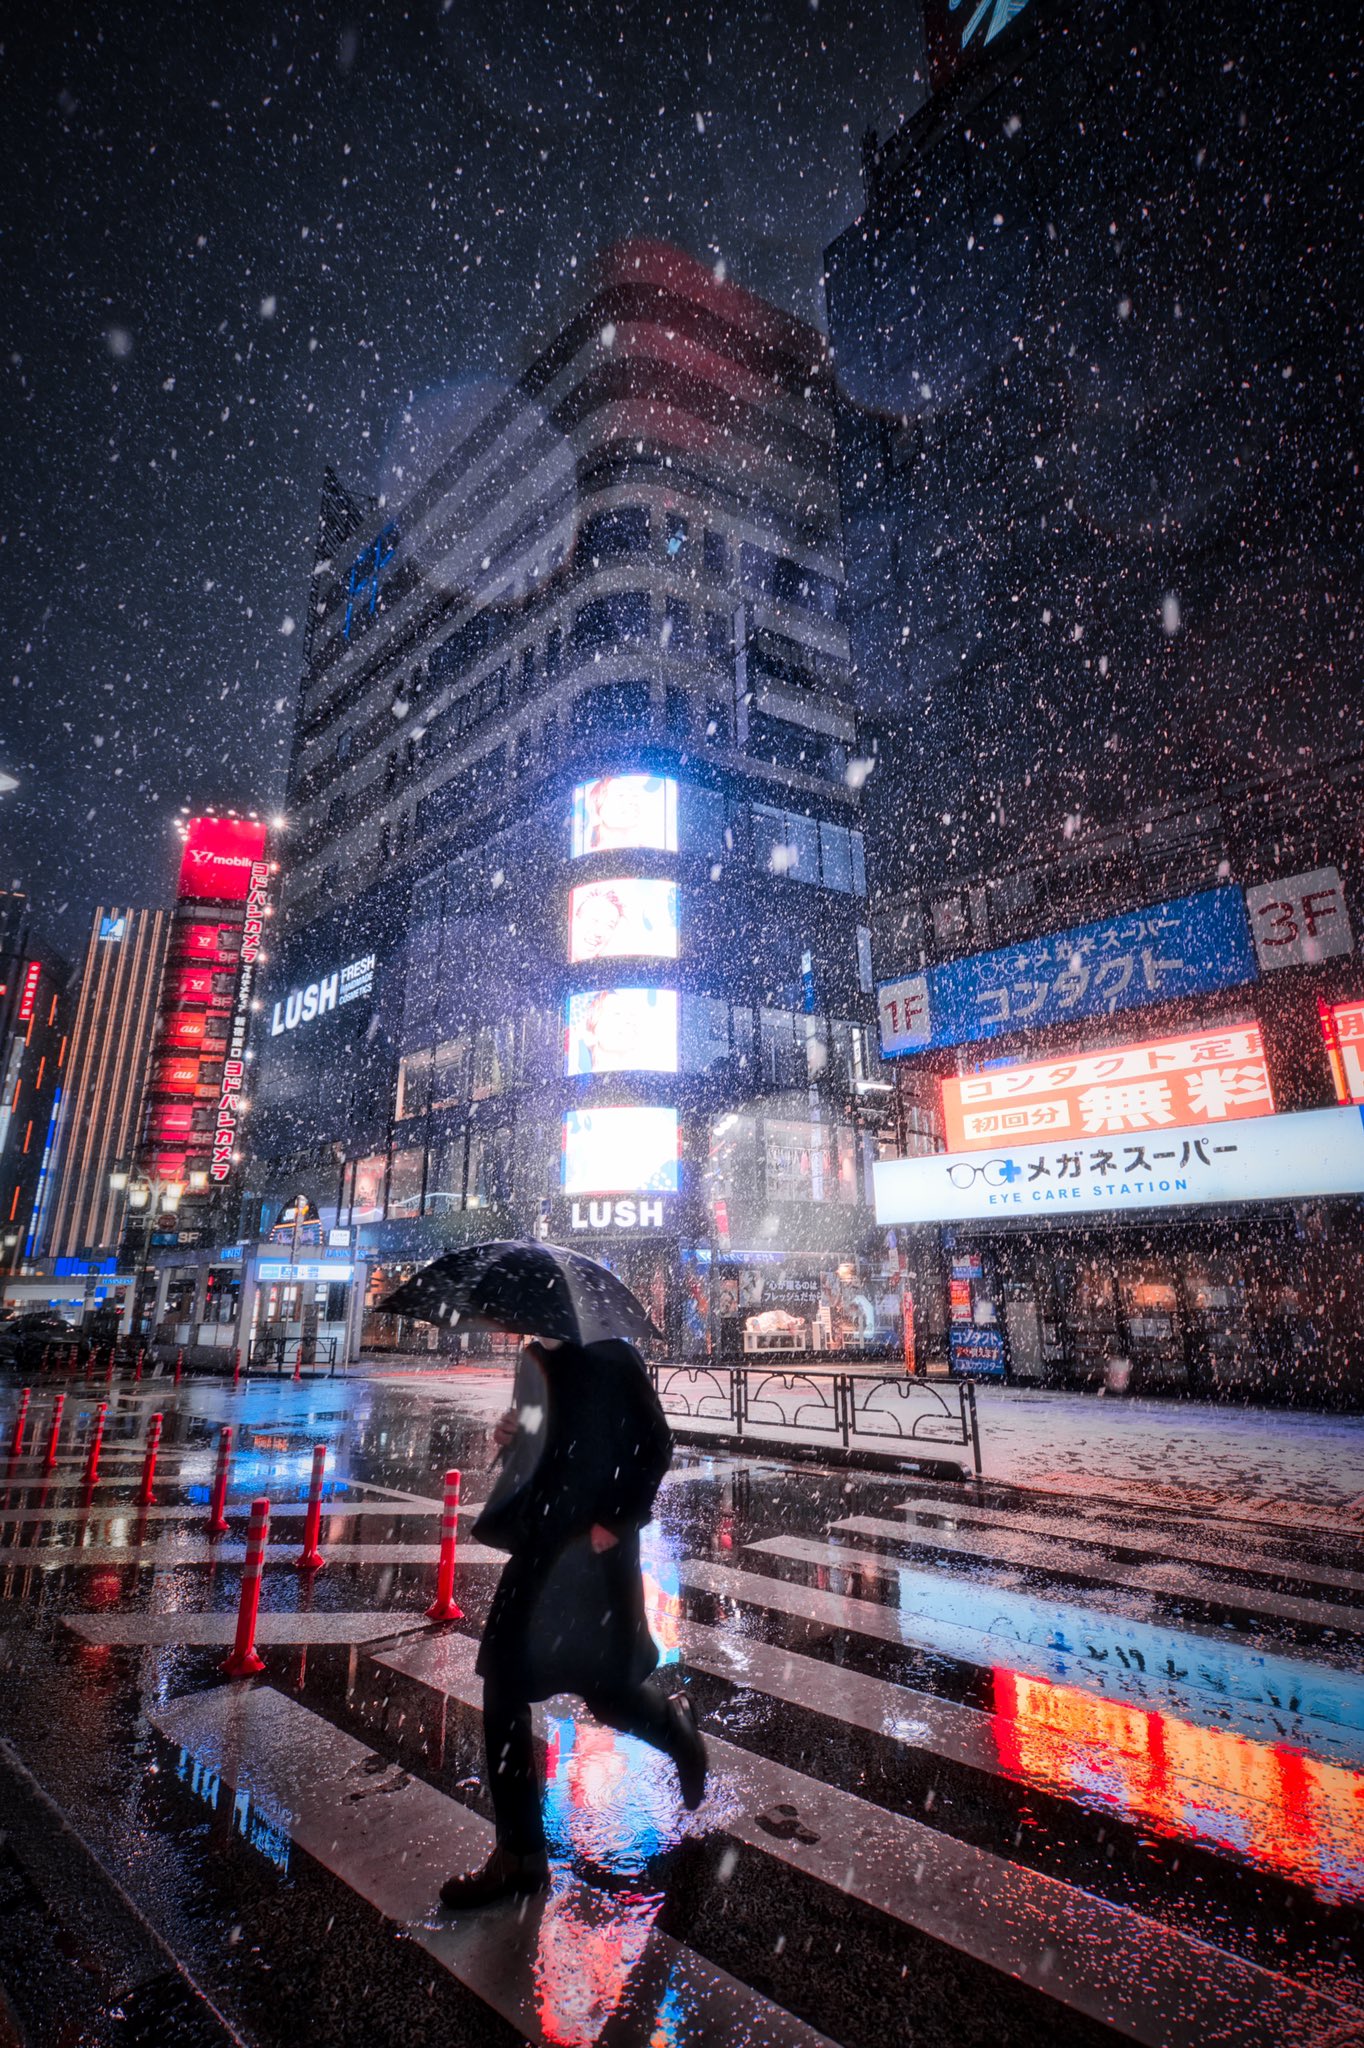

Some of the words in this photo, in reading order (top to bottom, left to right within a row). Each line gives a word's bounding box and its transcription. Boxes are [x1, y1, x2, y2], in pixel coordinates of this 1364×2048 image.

[240, 862, 270, 963] ヨドバシカメラ
[1258, 888, 1337, 946] 3F
[1034, 919, 1181, 969] メガネスーパー
[341, 953, 375, 984] FRESH
[976, 950, 1185, 1026] コンタクト
[271, 972, 338, 1036] LUSH
[339, 982, 373, 1005] COSMETICS
[884, 994, 924, 1033] 1F
[180, 1025, 200, 1033] au
[173, 1071, 194, 1079] au
[971, 1106, 1061, 1134] 初回分
[1077, 1062, 1271, 1134] 無料
[210, 1060, 244, 1181] ヨドバシカメラ
[1027, 1137, 1238, 1182] メガネスーパー
[988, 1191, 1021, 1205] EYE
[1032, 1187, 1081, 1201] CARE
[1093, 1179, 1188, 1196] STATION
[571, 1200, 663, 1228] LUSH
[178, 1232, 200, 1243] 3F
